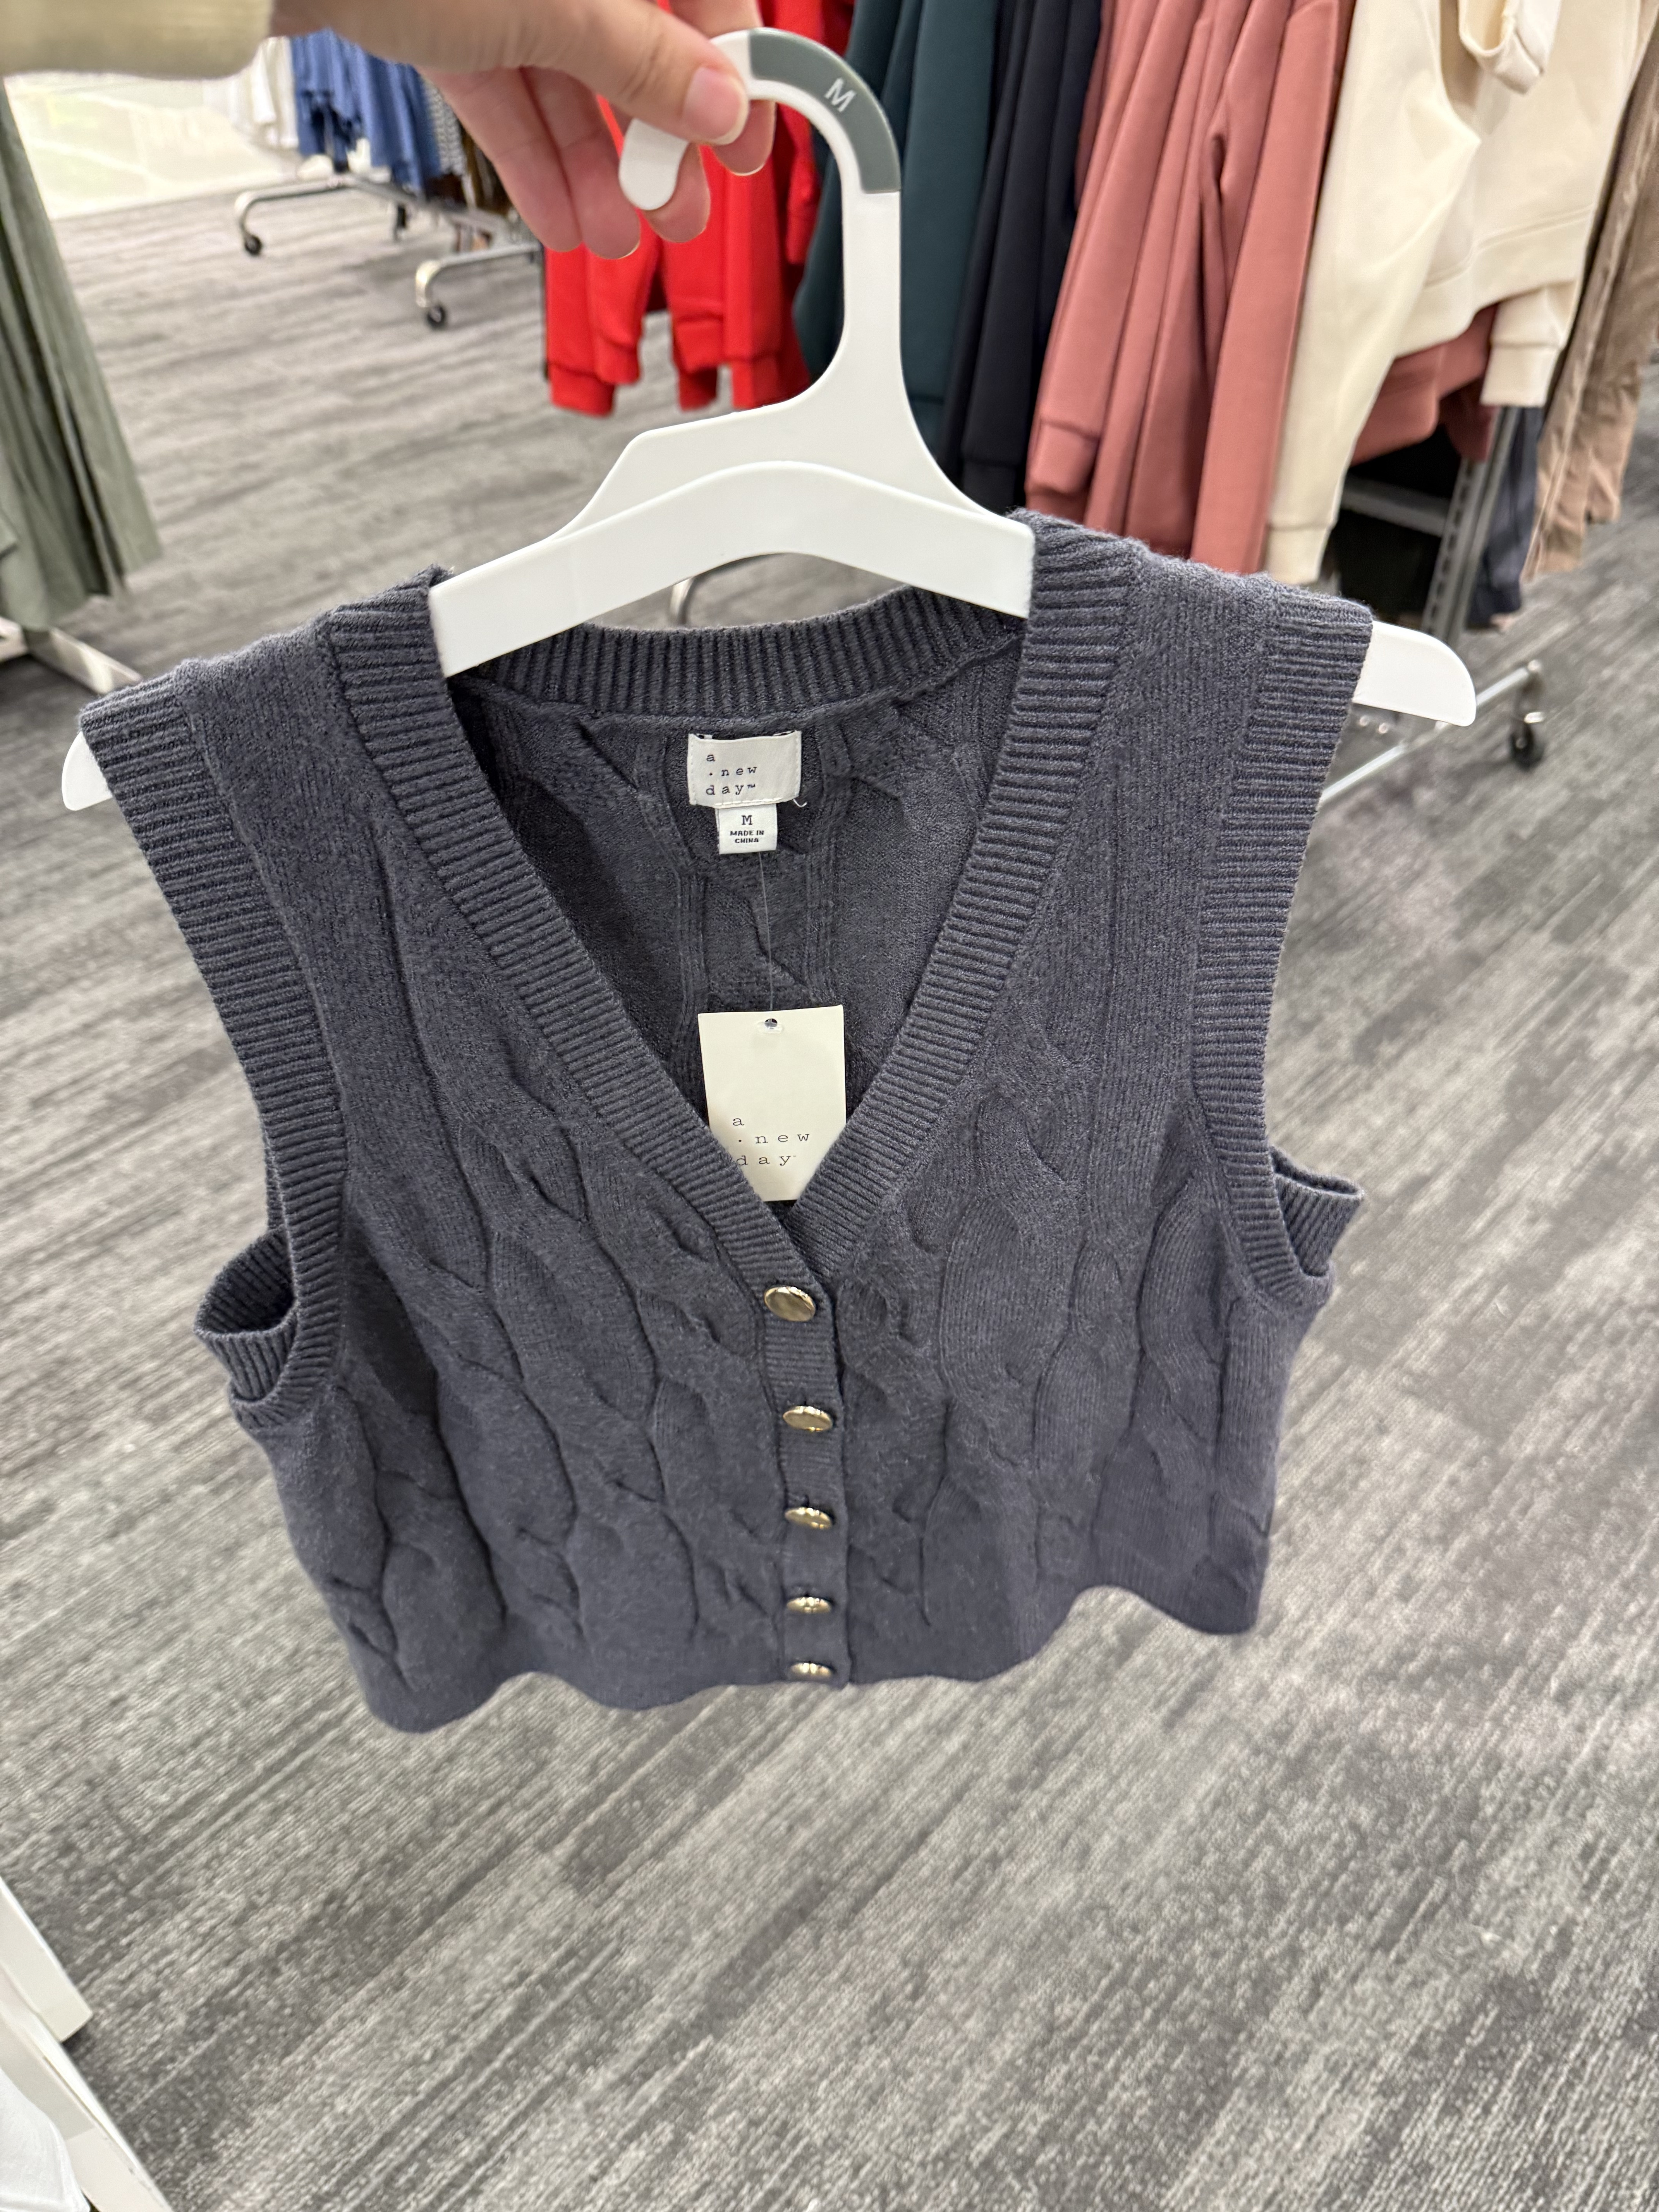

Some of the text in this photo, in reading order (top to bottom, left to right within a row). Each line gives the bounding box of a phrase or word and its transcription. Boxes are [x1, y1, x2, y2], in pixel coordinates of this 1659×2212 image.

[824, 78, 855, 112] M
[741, 815, 753, 825] M
[733, 1118, 744, 1126] a
